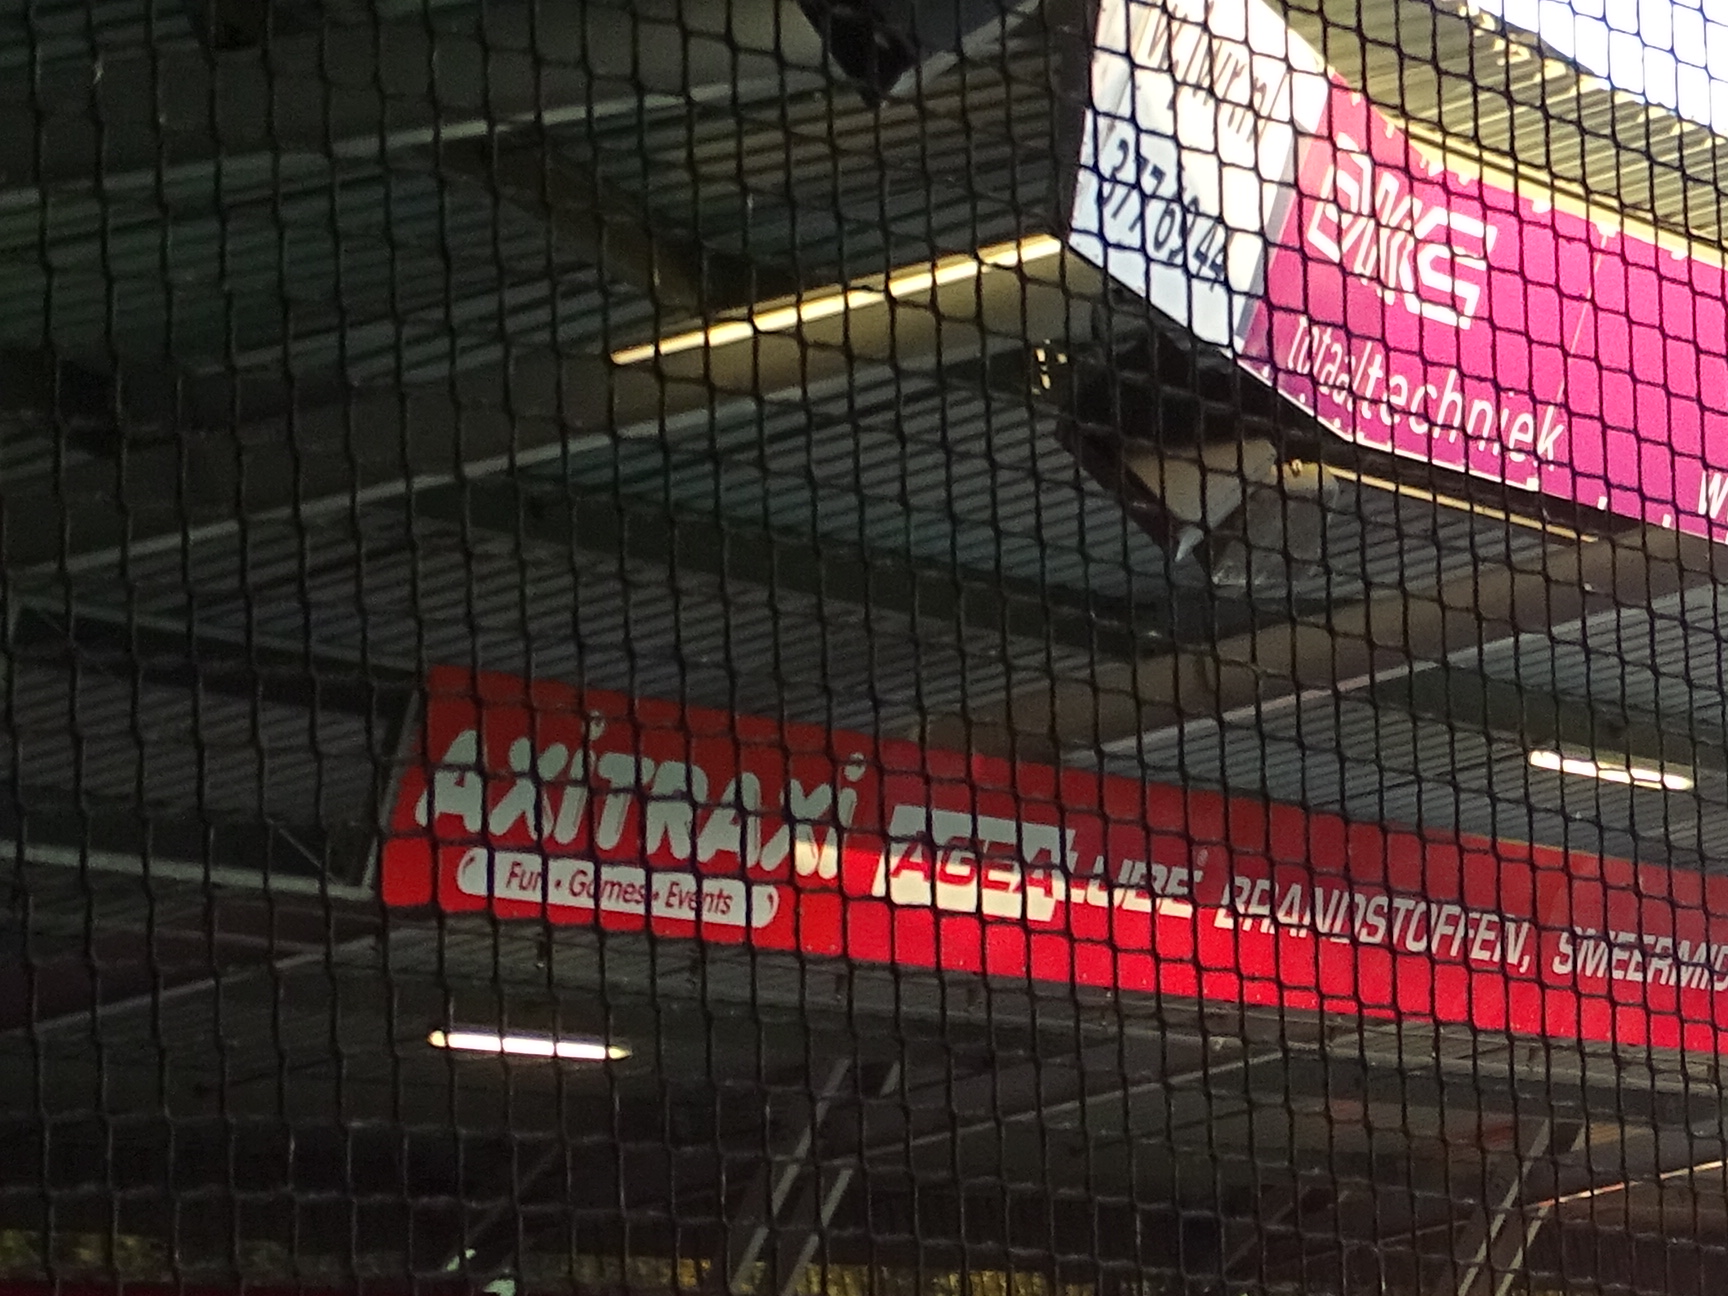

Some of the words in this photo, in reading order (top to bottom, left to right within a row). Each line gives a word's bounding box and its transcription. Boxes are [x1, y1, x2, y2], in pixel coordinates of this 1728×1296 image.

[505, 860, 543, 893] Fun
[568, 869, 646, 907] Games
[665, 881, 733, 917] Events
[1215, 873, 1532, 974] BRANDSTOFFEN,
